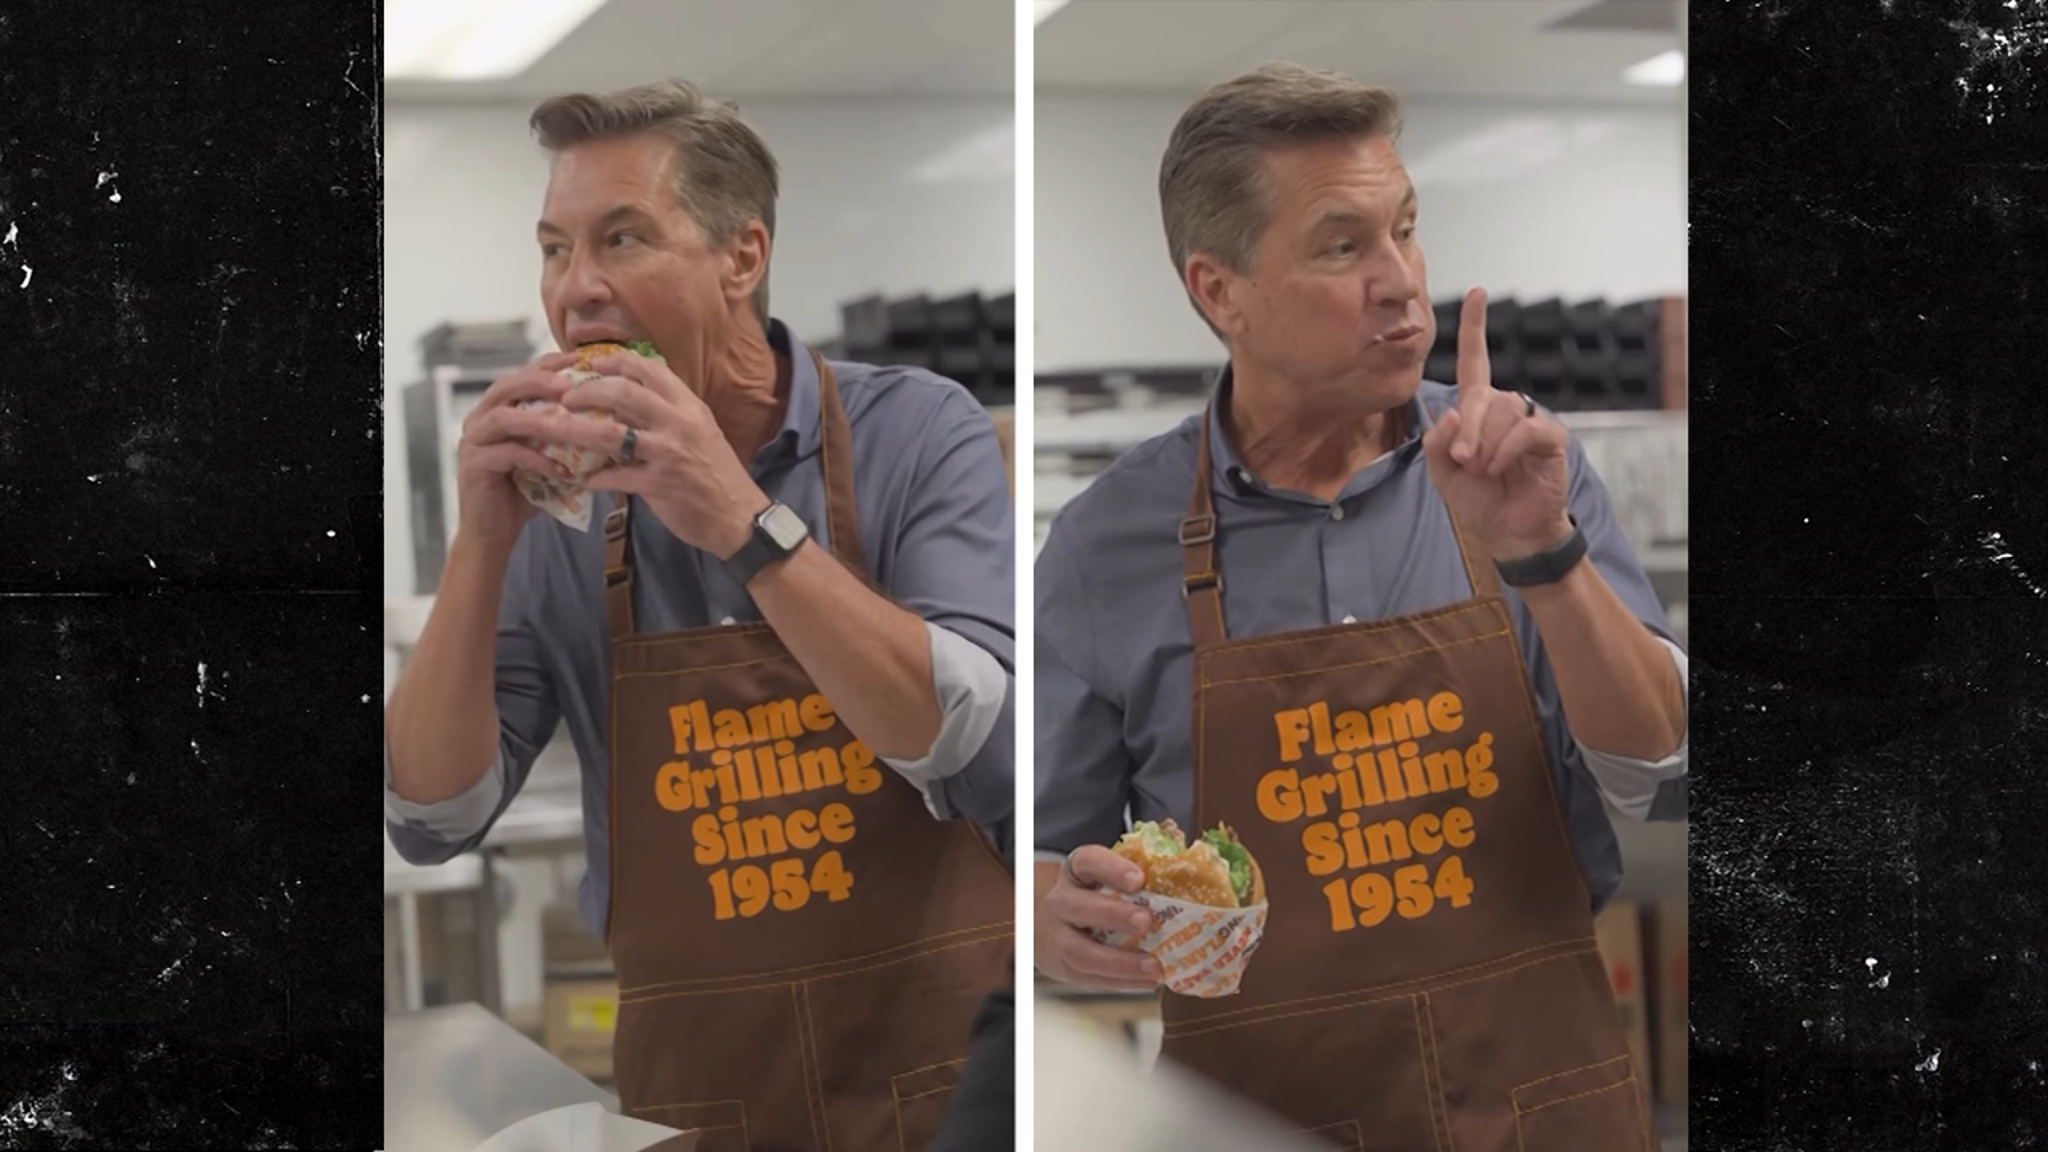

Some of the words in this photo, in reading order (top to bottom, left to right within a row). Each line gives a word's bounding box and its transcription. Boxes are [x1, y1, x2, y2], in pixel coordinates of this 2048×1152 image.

[669, 693, 836, 754] Flame
[1274, 690, 1464, 762] Flame
[655, 739, 883, 812] Grilling
[1256, 731, 1499, 822] Grilling
[691, 802, 856, 865] Since
[1302, 806, 1476, 876] Since
[708, 850, 854, 920] 1954
[1323, 855, 1474, 932] 1954
